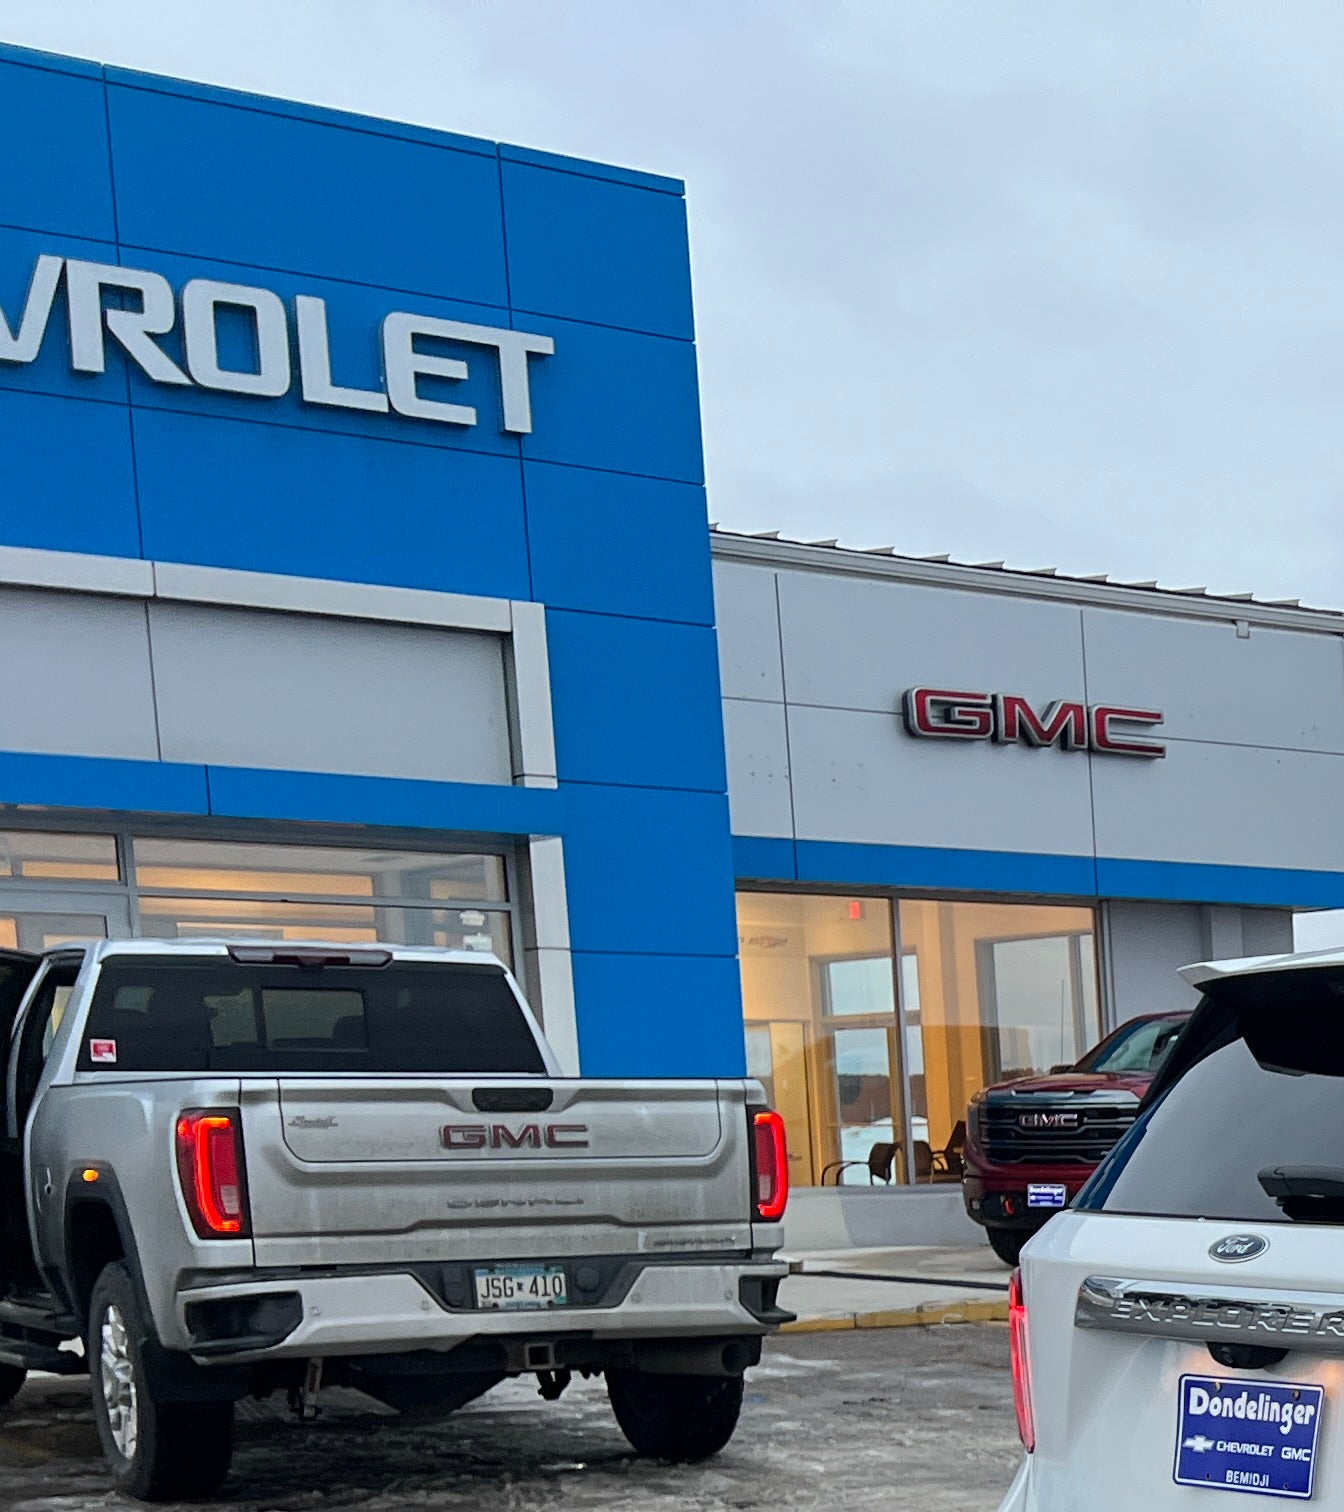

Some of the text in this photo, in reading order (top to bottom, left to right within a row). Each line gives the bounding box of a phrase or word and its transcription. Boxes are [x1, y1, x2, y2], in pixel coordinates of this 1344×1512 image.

[903, 686, 1166, 759] GMC
[1019, 1113, 1078, 1128] GMC
[440, 1124, 589, 1150] GMC
[1217, 1237, 1254, 1254] Ford
[481, 1275, 563, 1299] JSG 410
[1189, 1386, 1316, 1435] Dondelinger
[1216, 1441, 1312, 1462] CHEVROLET GMC
[1225, 1469, 1270, 1487] BEMIDJI
